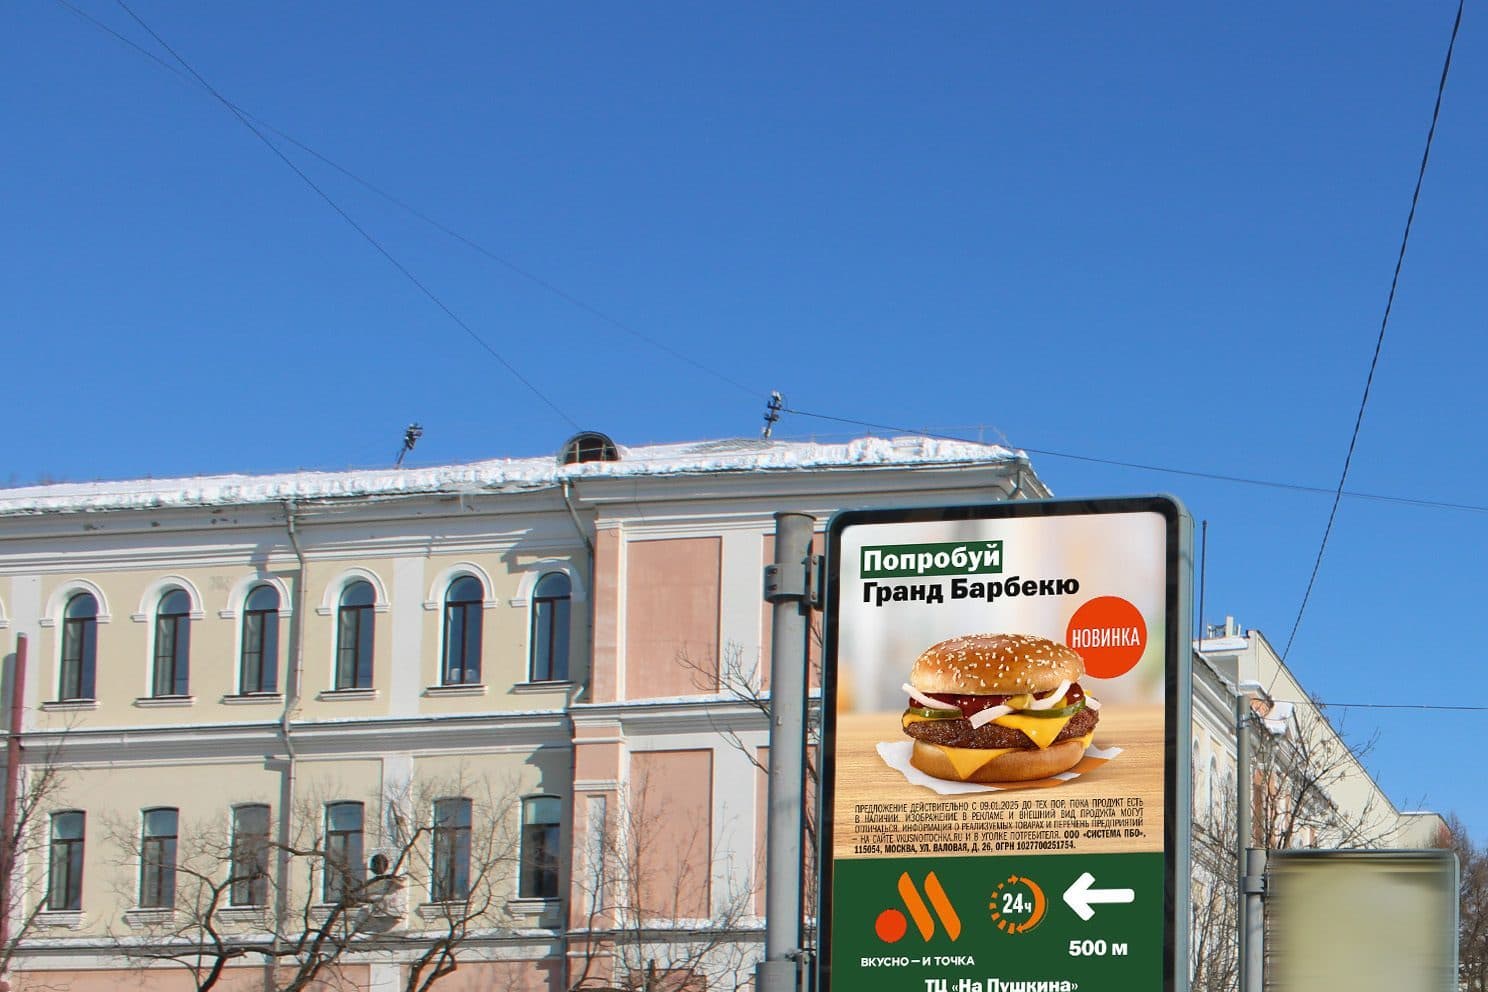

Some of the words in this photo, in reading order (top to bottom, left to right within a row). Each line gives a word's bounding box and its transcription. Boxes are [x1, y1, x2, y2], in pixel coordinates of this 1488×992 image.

[864, 543, 1000, 574] Попробуй
[863, 582, 944, 607] Гранд
[951, 576, 1080, 602] Барбекю
[1072, 627, 1140, 648] НОВИНКА
[854, 804, 908, 814] ПРЕДЛОЖЕНИЕ
[911, 802, 968, 813] ДЕЙСТВИТЕЛЬНО
[972, 802, 976, 810] С
[980, 801, 1019, 810] 09.01.2025
[1022, 801, 1032, 810] ДО
[1035, 800, 1047, 809] ТЕХ
[1070, 799, 1088, 808] ПОКА
[1092, 798, 1124, 808] ПРОДУКТ
[1127, 798, 1144, 806] ЕСТЬ
[855, 814, 860, 823] В
[905, 812, 958, 822] ИЗОБРАЖЕНИЕ
[962, 812, 967, 820] В
[972, 811, 1004, 820] РЕКЛАМЕ
[1009, 811, 1014, 820] И
[1020, 809, 1056, 819] ВНЕШНИЙ
[1061, 809, 1076, 819] ВИД
[1080, 809, 1116, 818] ПРОДУКТА
[1121, 808, 1144, 816] МОГУТ
[903, 822, 952, 832] ИНФОРМАЦИЯ
[955, 823, 959, 831] О
[962, 821, 1012, 831] РЕАЛИЗУЕМЫХ
[1015, 820, 1043, 830] ТОВАРАХ
[1046, 820, 1051, 829] И
[1054, 820, 1089, 829] ПЕРЕЧЕНЬ
[1092, 817, 1144, 829] ПРЕДПРИЯТИЙ
[860, 834, 869, 843] НА
[873, 833, 893, 843] САЙТЕ
[966, 833, 970, 841] И
[974, 833, 978, 841] В
[982, 831, 1008, 841] УГОЛКЕ
[1011, 831, 1060, 840] ПОТРЕБИТЕЛЯ.
[1064, 830, 1080, 839] ООО
[1083, 829, 1121, 839] «СИСТЕМА
[855, 844, 883, 854] 115054,
[885, 844, 917, 854] МОСКВА,
[920, 843, 931, 852] УЛ.
[933, 842, 969, 852] ВАЛОВАЯ,
[972, 842, 980, 852] Д.
[995, 842, 1014, 850] ОГРН
[1002, 893, 1032, 914] 24ч
[1068, 939, 1107, 956] 500
[1111, 943, 1128, 956] м
[860, 957, 910, 967] ВКУСНО
[922, 957, 931, 966] И
[934, 956, 975, 966] ТОЧКА
